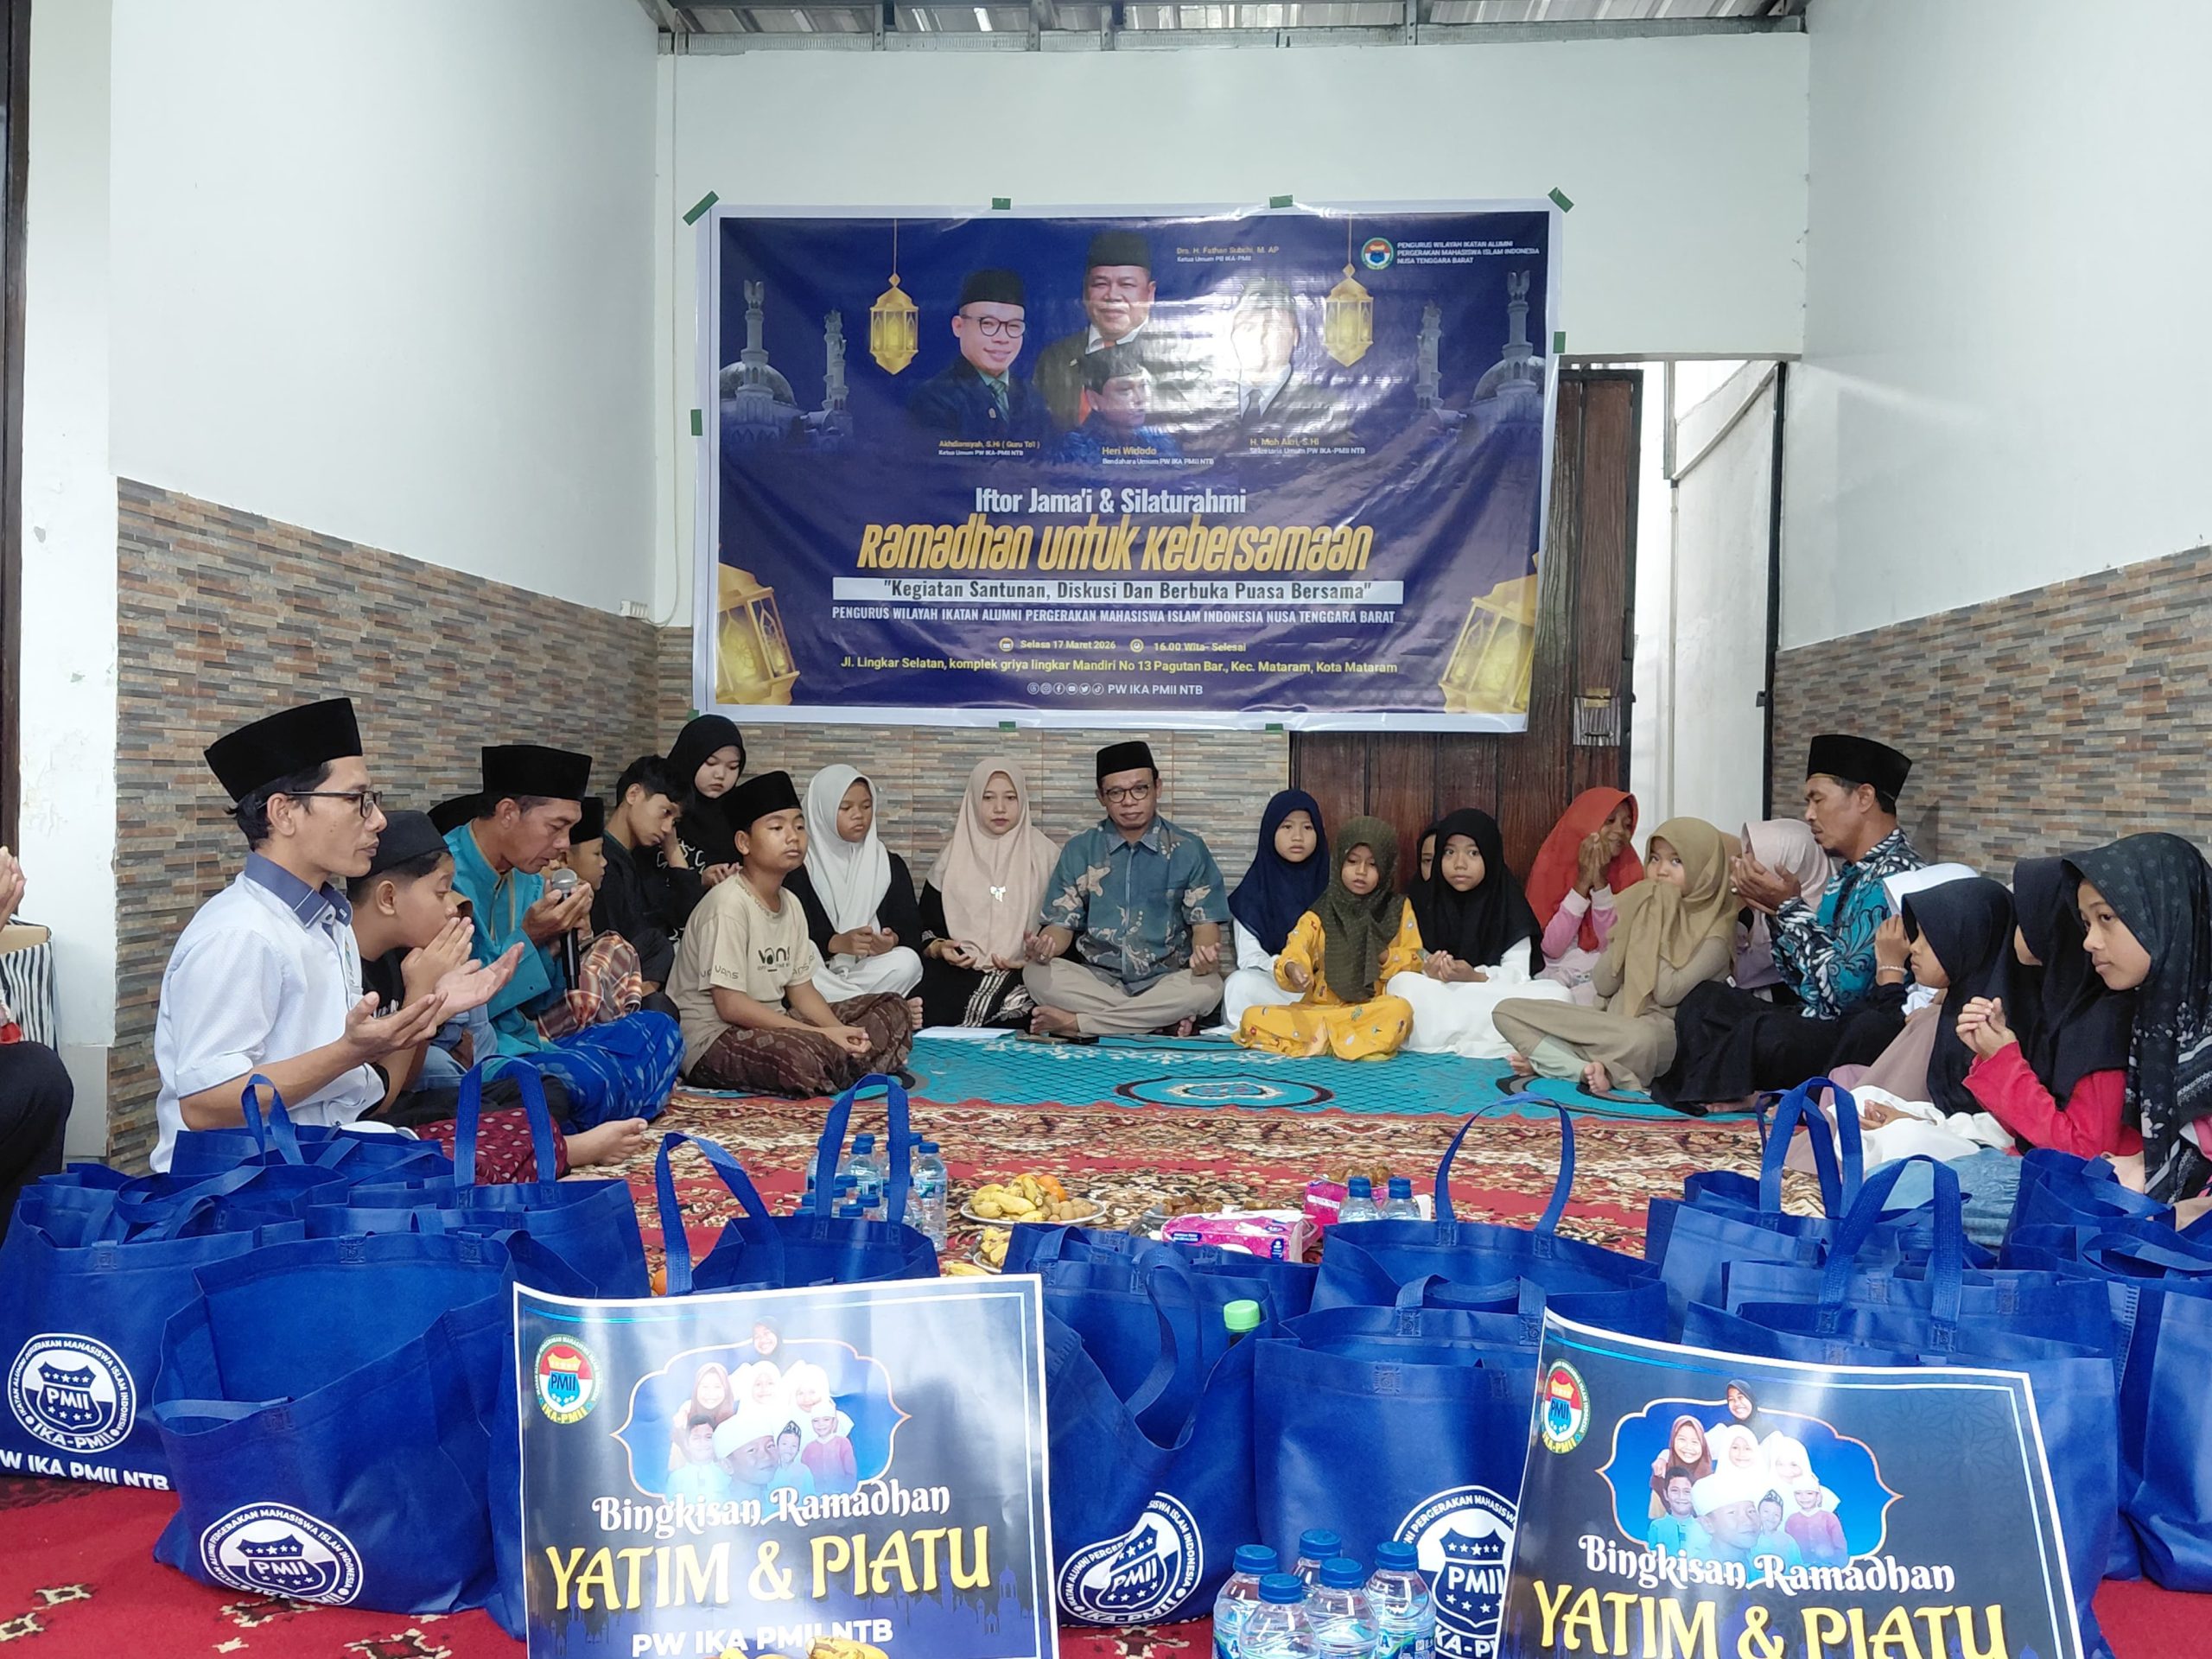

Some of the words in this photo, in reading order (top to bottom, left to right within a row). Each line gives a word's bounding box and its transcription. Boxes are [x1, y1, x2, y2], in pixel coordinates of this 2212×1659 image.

[1102, 446, 1121, 455] Heri
[1122, 446, 1157, 455] Widodo
[976, 486, 1023, 513] Iftor
[1028, 486, 1092, 514] Jama'i
[1099, 487, 1115, 513] &
[1121, 487, 1247, 514] Silaturahmi
[1037, 513, 1141, 571] untuk
[884, 580, 963, 600] "Kegiatan
[969, 581, 1051, 601] Santunan,
[1058, 582, 1116, 600] Diskusi
[1123, 582, 1154, 600] Dan
[1160, 582, 1229, 600] Berbuka
[1236, 582, 1284, 600] Puasa
[1291, 582, 1372, 600] Bersama"
[832, 607, 890, 620] PENGURUS
[893, 607, 938, 620] WILAYAH
[942, 608, 979, 620] IKATAN
[982, 608, 1021, 621] ALUMNI
[1026, 609, 1096, 622] PERGERAKAN
[1100, 610, 1165, 622] MAHASISWA
[1167, 610, 1201, 622] ISLAM
[1204, 610, 1263, 623] INDONESIA
[1267, 610, 1296, 623] NUSA
[1300, 610, 1357, 624] TENGGARA
[1360, 611, 1395, 624] BARAT
[1020, 639, 1051, 648] Selasa
[1053, 640, 1065, 649] 17
[1066, 640, 1092, 649] Maret
[1094, 641, 1116, 650] 2026
[1154, 642, 1181, 652] 16.00
[1211, 643, 1246, 652] Selesai
[841, 657, 854, 668] Jl.
[857, 657, 899, 670] Lingkar
[902, 657, 947, 671] Selatan,
[949, 658, 997, 671] komplek
[1001, 659, 1028, 672] griya
[1032, 659, 1070, 672] lingkar
[1073, 660, 1116, 671] Mandiri
[1119, 660, 1135, 671] No
[1137, 660, 1152, 672] 13
[1154, 661, 1201, 674] Pagutan
[1230, 662, 1255, 672] Kec.
[1258, 662, 1313, 674] Mataram,
[1316, 662, 1343, 672] Kota
[1344, 662, 1398, 673] Mataram
[1108, 684, 1128, 695] PW
[1130, 684, 1149, 695] IKA
[1152, 684, 1177, 695] PMII
[1179, 684, 1203, 695] NTB
[64, 1340, 113, 1367] MAHASISWA
[111, 1364, 128, 1391] ISLAM
[551, 1374, 577, 1391] PMII
[46, 1388, 90, 1410] PMII
[118, 1391, 130, 1431] INDONESIA
[1550, 1399, 1570, 1420] PMII
[33, 1422, 112, 1449] IKA-PMII
[0, 1449, 22, 1469] W
[28, 1455, 67, 1478] IKA
[69, 1462, 118, 1484] PMII
[123, 1470, 170, 1491] NTB
[592, 1493, 761, 1540] Bingkisan
[760, 1478, 950, 1528] Ramadhan
[1412, 1495, 1473, 1533] PERGERAKAN
[260, 1509, 318, 1535] MAHASISWA
[318, 1532, 344, 1556] ISLAM
[340, 1549, 355, 1588] INDONESIA
[1068, 1556, 1090, 1583] ALUMNI
[1169, 1509, 1189, 1536] ISLAM
[1184, 1533, 1196, 1587] INDONESIA
[253, 1561, 308, 1575] PMII
[546, 1541, 731, 1611] YATIM
[748, 1540, 797, 1602] &
[810, 1525, 991, 1599] PIATU
[1111, 1557, 1158, 1592] PMII
[1578, 1534, 1746, 1589] Bingkisan
[1745, 1554, 1955, 1597] Ramadhan
[1080, 1598, 1178, 1623] IKA-PMII
[1533, 1580, 1719, 1659] YATIM
[1737, 1605, 1787, 1659] &
[1801, 1604, 2010, 1659] PIATU
[632, 1631, 686, 1657] PW
[695, 1627, 748, 1654] IKA
[831, 1618, 893, 1643] NTB
